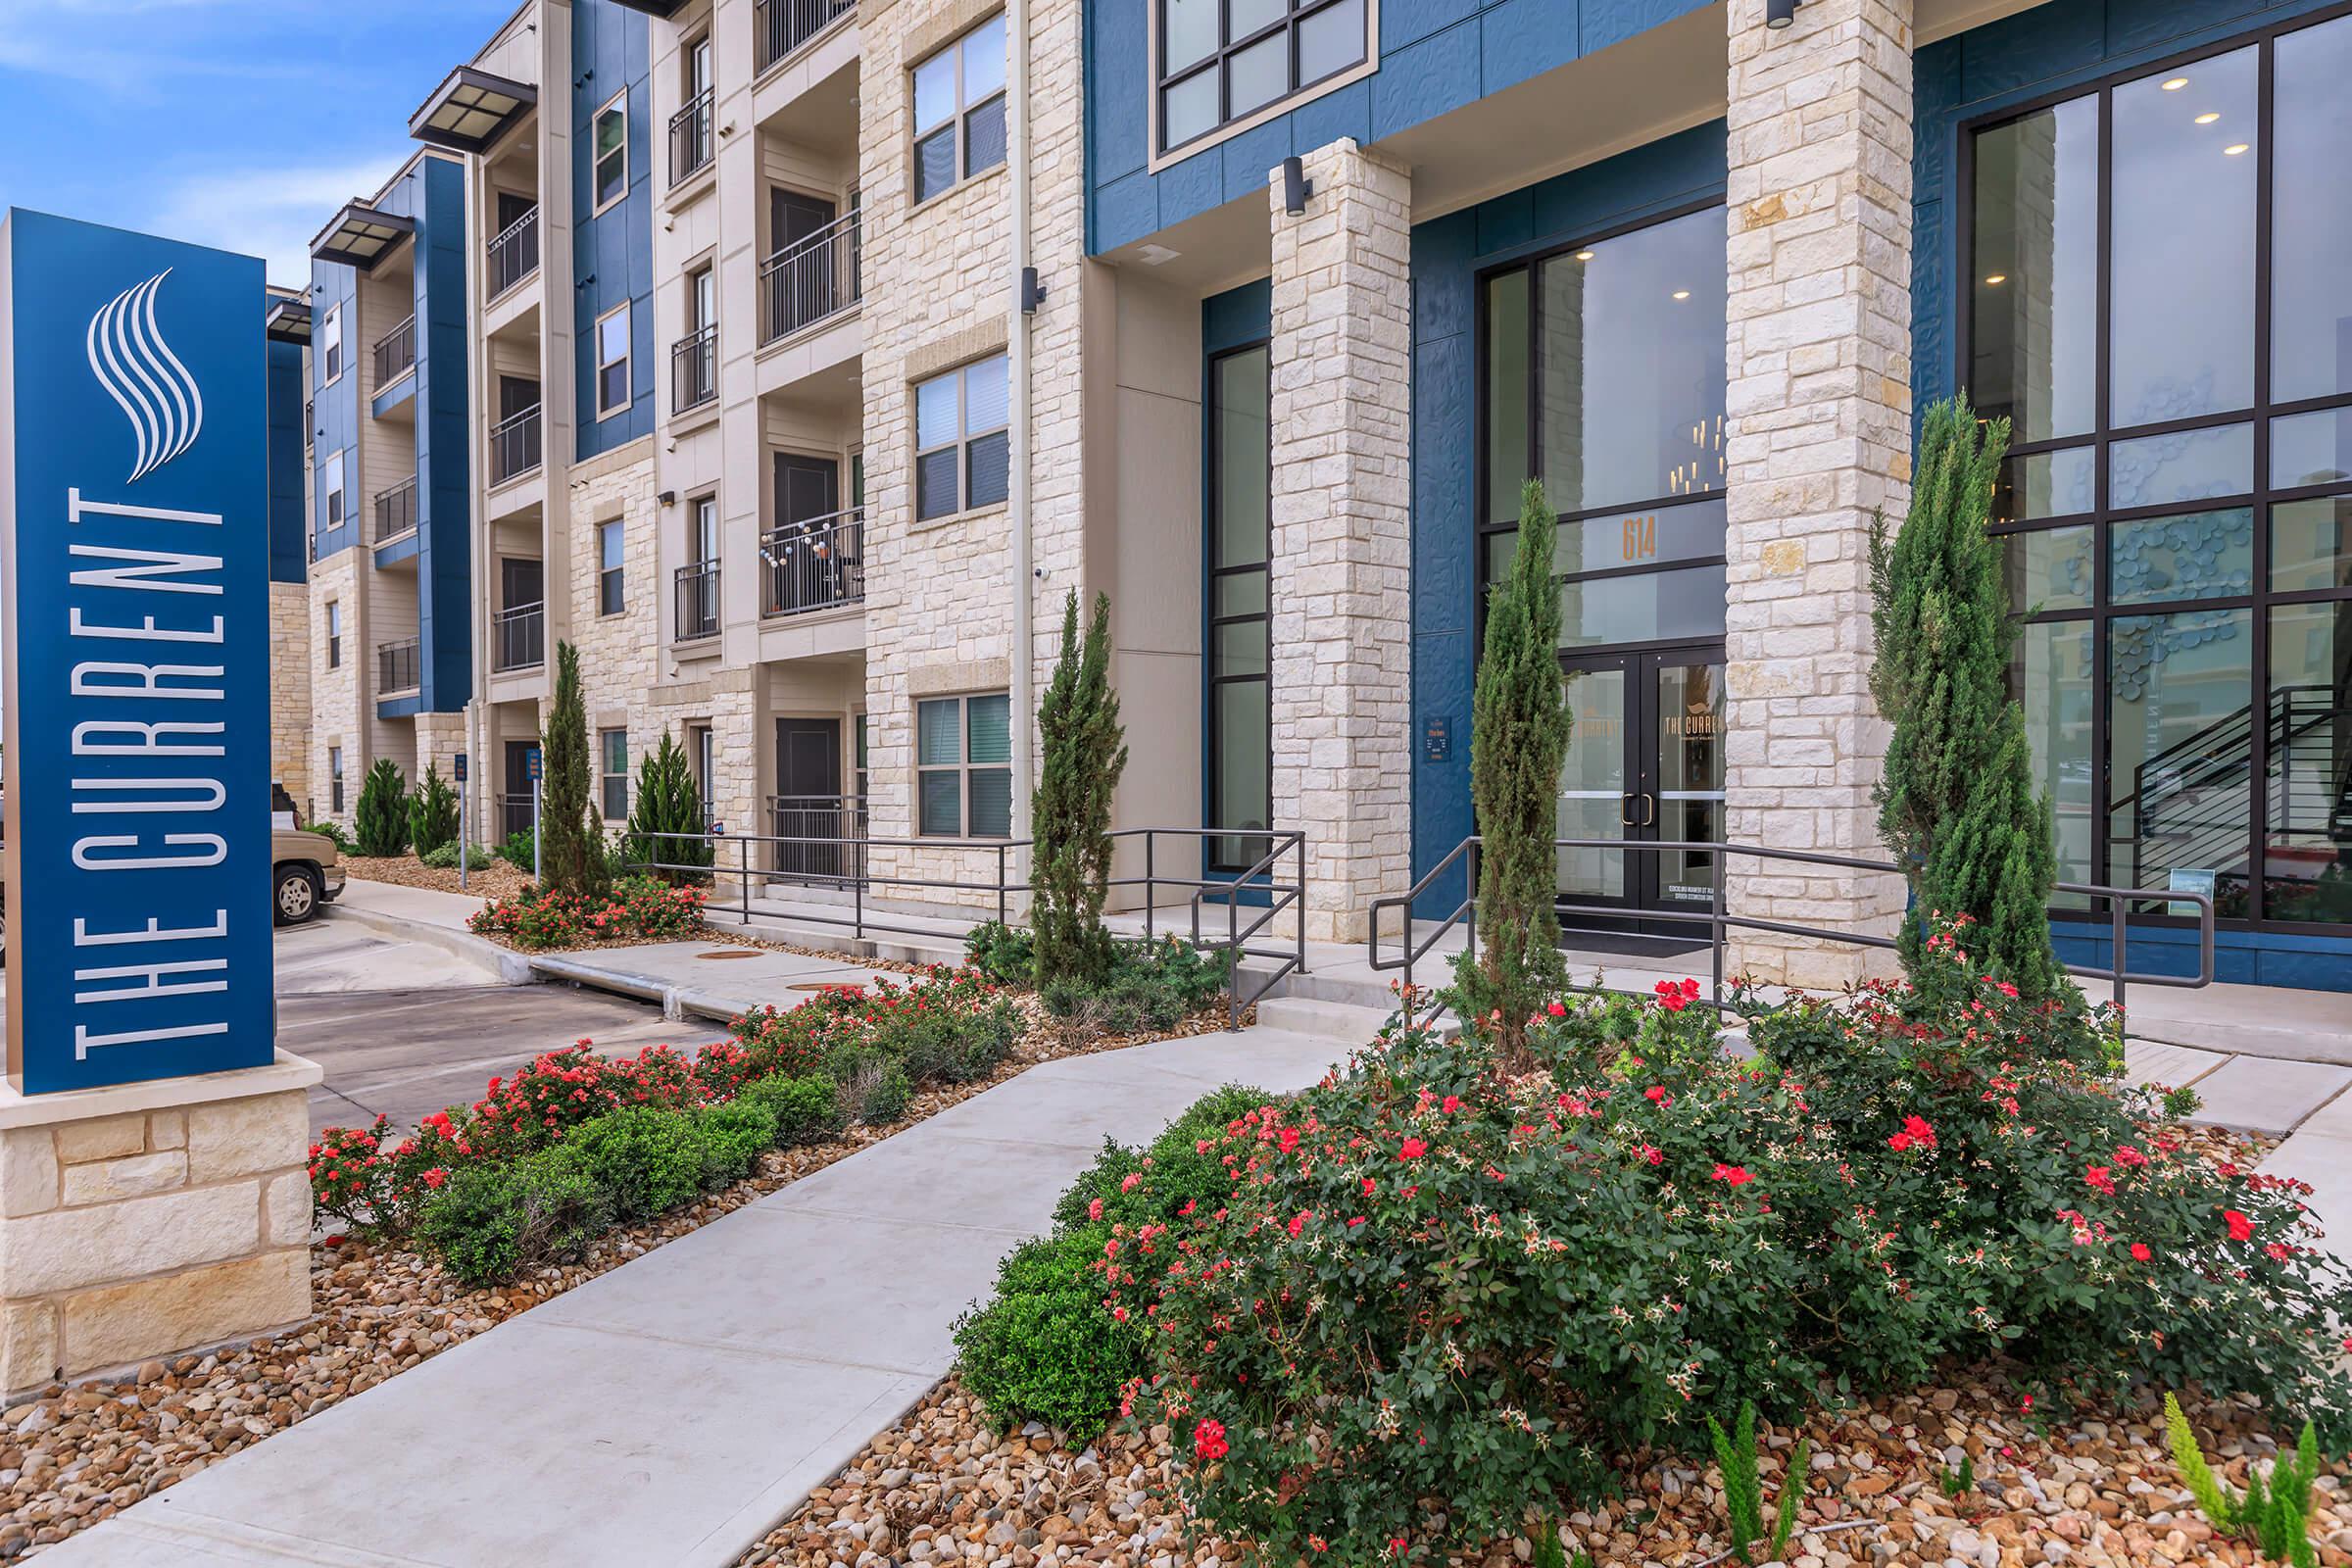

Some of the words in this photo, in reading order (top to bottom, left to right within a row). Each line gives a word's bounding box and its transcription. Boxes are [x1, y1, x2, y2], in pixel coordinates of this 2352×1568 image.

[1623, 515, 1656, 561] 614
[69, 486, 228, 871] CURRENT
[1665, 716, 1682, 735] THE
[74, 908, 228, 1061] THE
